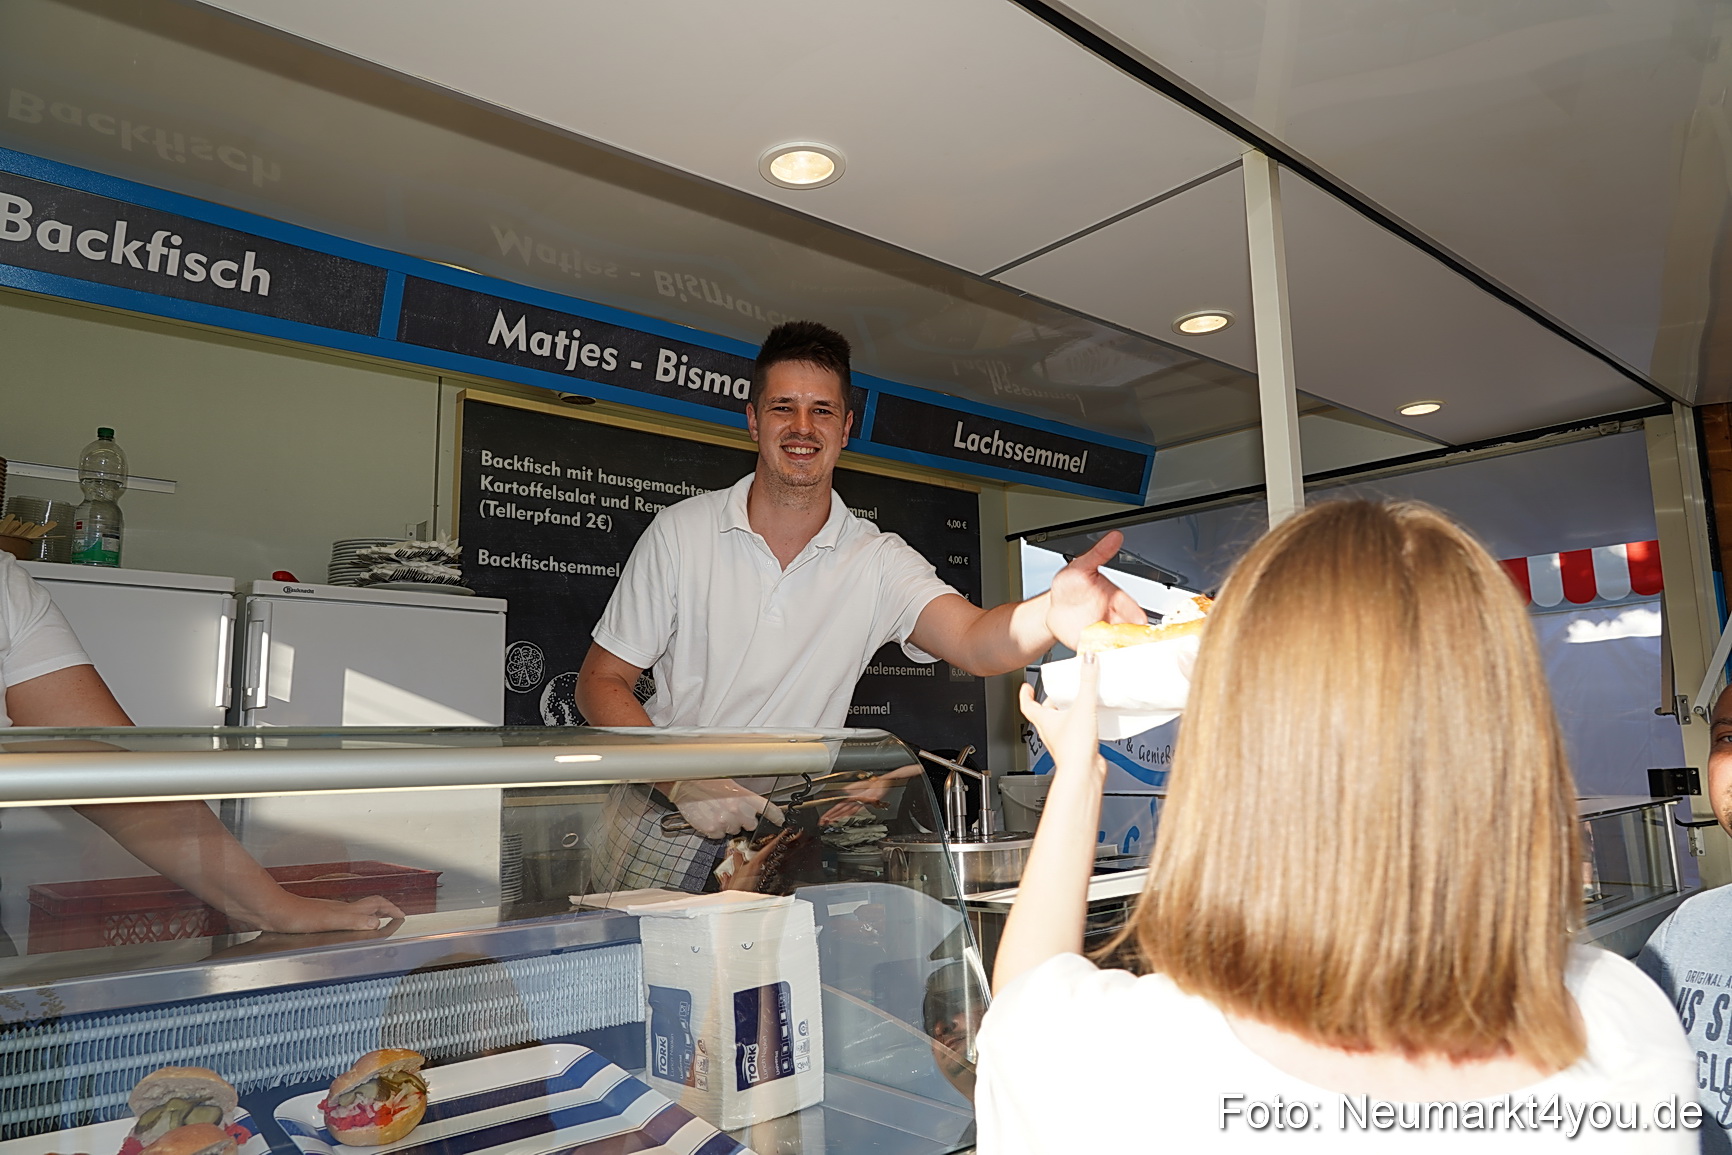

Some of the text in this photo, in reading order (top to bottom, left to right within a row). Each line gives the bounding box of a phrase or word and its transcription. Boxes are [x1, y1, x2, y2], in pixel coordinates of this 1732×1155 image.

[0, 192, 272, 297] Backfisch
[487, 308, 619, 371] Matjes
[655, 347, 752, 400] Bisma
[953, 420, 1088, 474] Lachssemmel
[481, 449, 561, 478] Backfisch
[566, 466, 593, 482] mit
[480, 474, 667, 514] Kartoffelsalat und Rem
[479, 499, 613, 533] (Tellerpfand 2€)
[946, 518, 961, 529] 4,00
[478, 548, 621, 578] Backfischsemmel
[948, 555, 963, 565] 4,00
[865, 661, 935, 676] nelensemmel
[848, 701, 891, 715] semmel
[953, 703, 968, 714] 4,00
[1685, 969, 1723, 987] ORIGINAL
[659, 1037, 667, 1074] TORK
[748, 1045, 759, 1082] TORK
